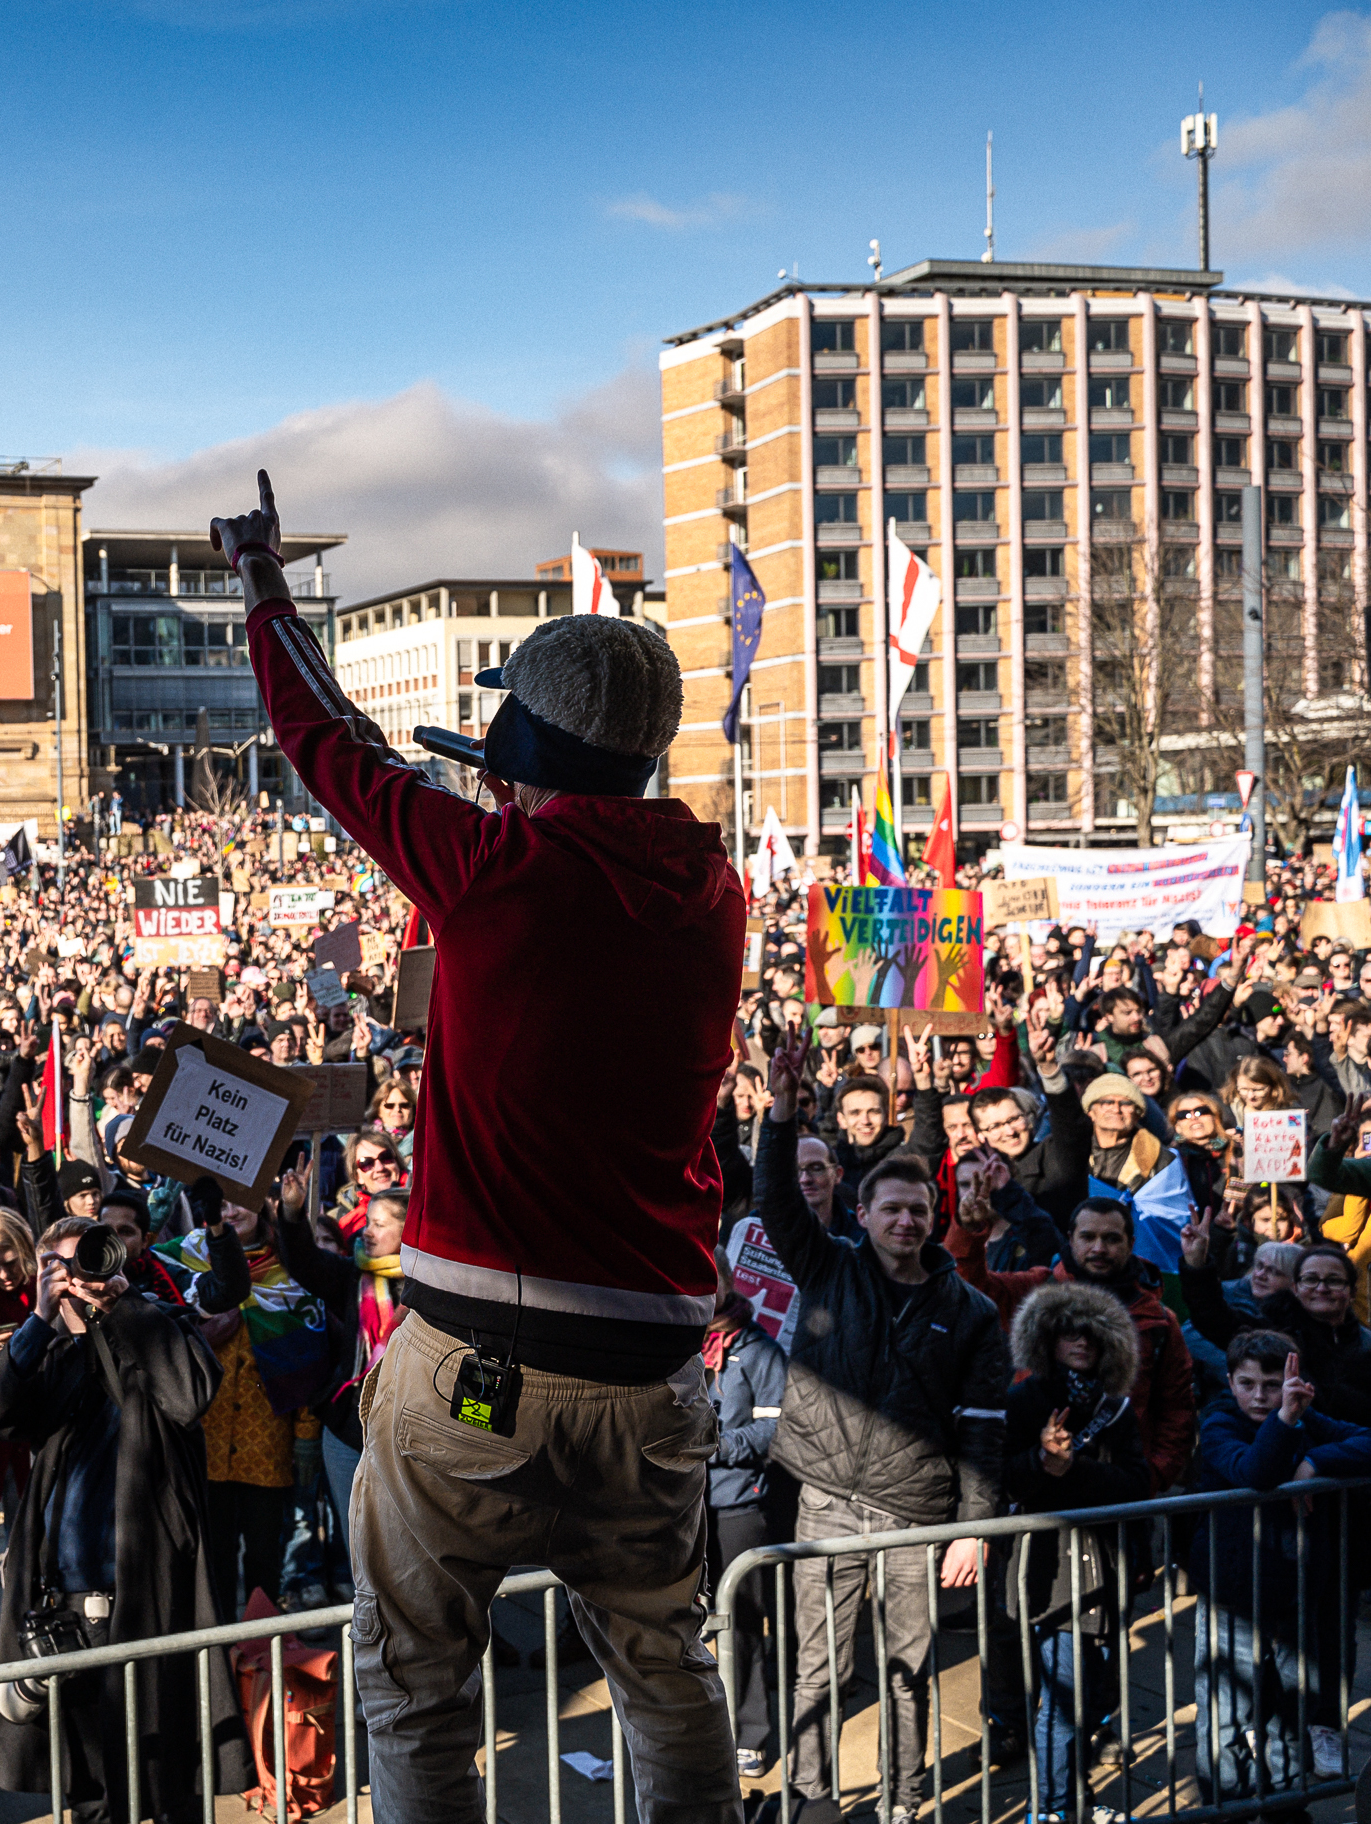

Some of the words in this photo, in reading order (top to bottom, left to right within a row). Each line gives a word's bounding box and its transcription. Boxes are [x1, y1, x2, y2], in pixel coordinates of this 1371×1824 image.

[207, 1078, 248, 1111] Kein
[194, 1104, 239, 1138] Platz
[163, 1121, 192, 1145] für
[191, 1133, 249, 1171] Nazis!
[735, 1269, 762, 1287] test
[471, 1403, 481, 1417] 2
